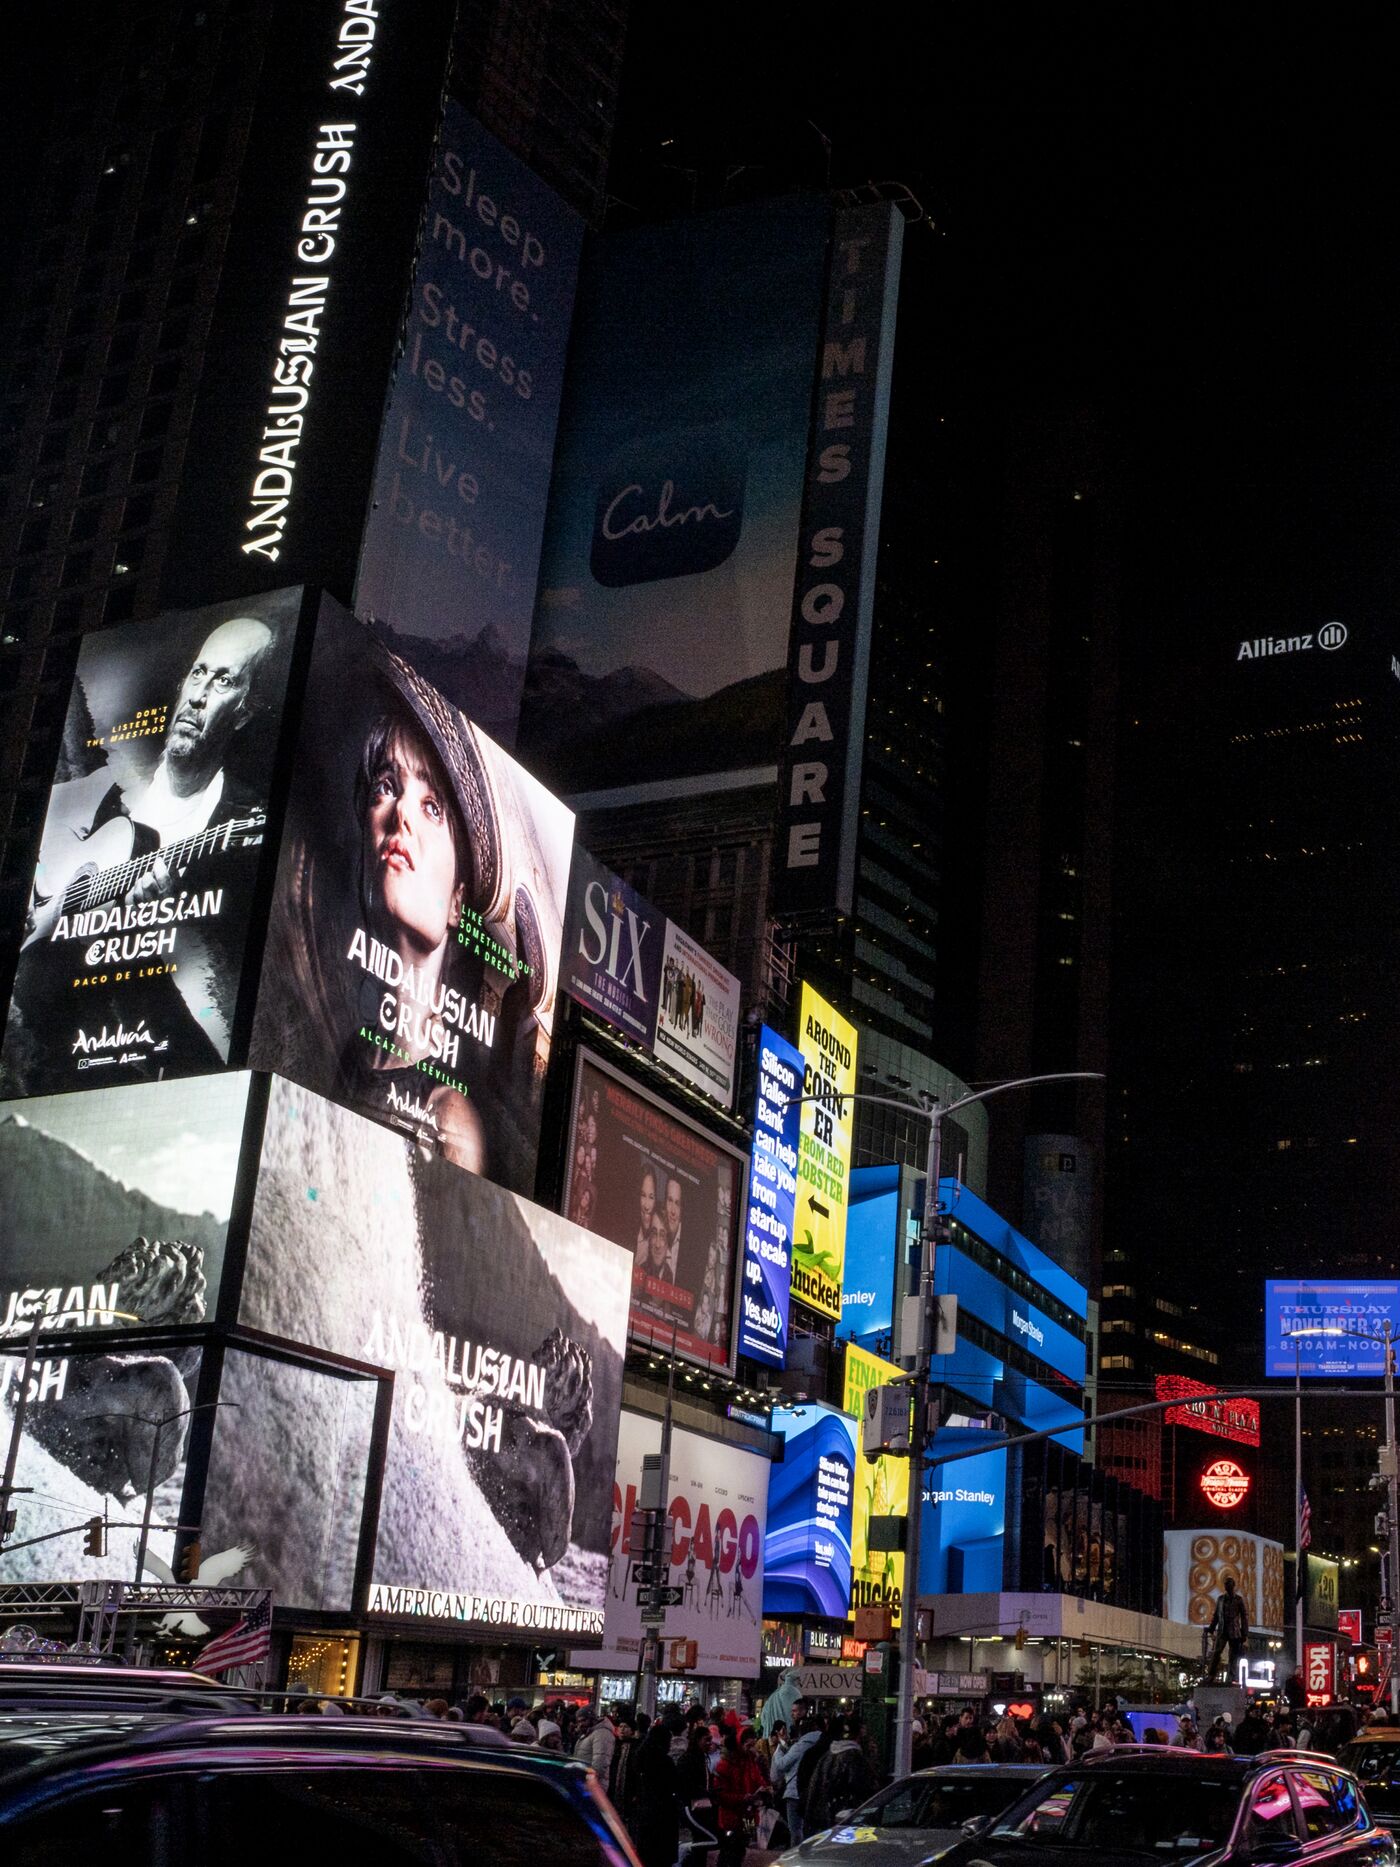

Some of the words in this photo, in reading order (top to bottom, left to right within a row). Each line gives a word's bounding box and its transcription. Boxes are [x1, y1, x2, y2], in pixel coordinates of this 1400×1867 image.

[440, 150, 545, 269] Sleep
[432, 212, 540, 321] more.
[242, 277, 329, 562] ANDALUSIAN
[298, 123, 357, 263] CRUSH
[419, 281, 534, 400] Stress
[819, 237, 873, 484] TIMES
[409, 334, 495, 432] less.
[398, 414, 480, 505] Live
[602, 480, 734, 541] Calm
[1237, 634, 1313, 661] Allianz
[136, 706, 168, 719] DON'T
[787, 527, 845, 868] SQUARE
[86, 737, 105, 748] THE
[110, 725, 165, 744] MAESTROS
[112, 719, 148, 733] LISTEN
[154, 715, 166, 726] TO
[51, 889, 223, 942] ANDALUSIAN
[461, 906, 484, 926] LIKE
[85, 928, 177, 966] CRUSH
[457, 933, 471, 948] OF
[474, 946, 480, 956] A
[459, 918, 514, 963] SOMETHING
[516, 960, 535, 978] OUT
[578, 881, 651, 1002] SIX
[73, 975, 108, 988] PACO
[115, 971, 131, 981] DE
[140, 964, 178, 977] LUCÍA
[347, 928, 496, 1048] ANDALUSIAN
[72, 1020, 155, 1055] Andalucía
[359, 1027, 411, 1063] ALCÁZAR
[380, 992, 460, 1069] CRUSH
[704, 1019, 734, 1059] WRONG
[805, 1014, 851, 1071] AROUND
[761, 1047, 796, 1090] Silicon
[819, 1051, 837, 1081] THE
[760, 1071, 790, 1114] Valley
[804, 1063, 848, 1121] CORN-
[757, 1097, 785, 1134] Bank
[814, 1106, 833, 1148] ER
[755, 1129, 776, 1155] can
[776, 1136, 797, 1172] help
[827, 1151, 844, 1178] RED
[752, 1176, 777, 1209] from
[754, 1152, 777, 1182] take
[776, 1165, 796, 1195] you
[750, 1206, 788, 1243] startup
[748, 1230, 760, 1254] to
[761, 1238, 788, 1269] scale
[746, 1259, 763, 1285] up.
[744, 1295, 761, 1325] Yes,
[761, 1305, 779, 1329] svb
[1280, 1305, 1391, 1315] THURSDAY
[1281, 1317, 1368, 1338] NOVEMBER
[363, 1309, 546, 1410] ANDALUSIAN
[405, 1384, 503, 1454] CRUSH
[1214, 1464, 1237, 1476] HOT
[955, 1489, 995, 1506] Stanley
[1214, 1491, 1237, 1504] NOW
[373, 1586, 467, 1620] AMERICAN
[472, 1597, 519, 1625] EAGLE
[522, 1603, 604, 1635] OUTFITTERS
[810, 1631, 828, 1648] BLUE
[972, 1675, 987, 1689] OPEN
[1309, 1646, 1331, 1691] tkts
